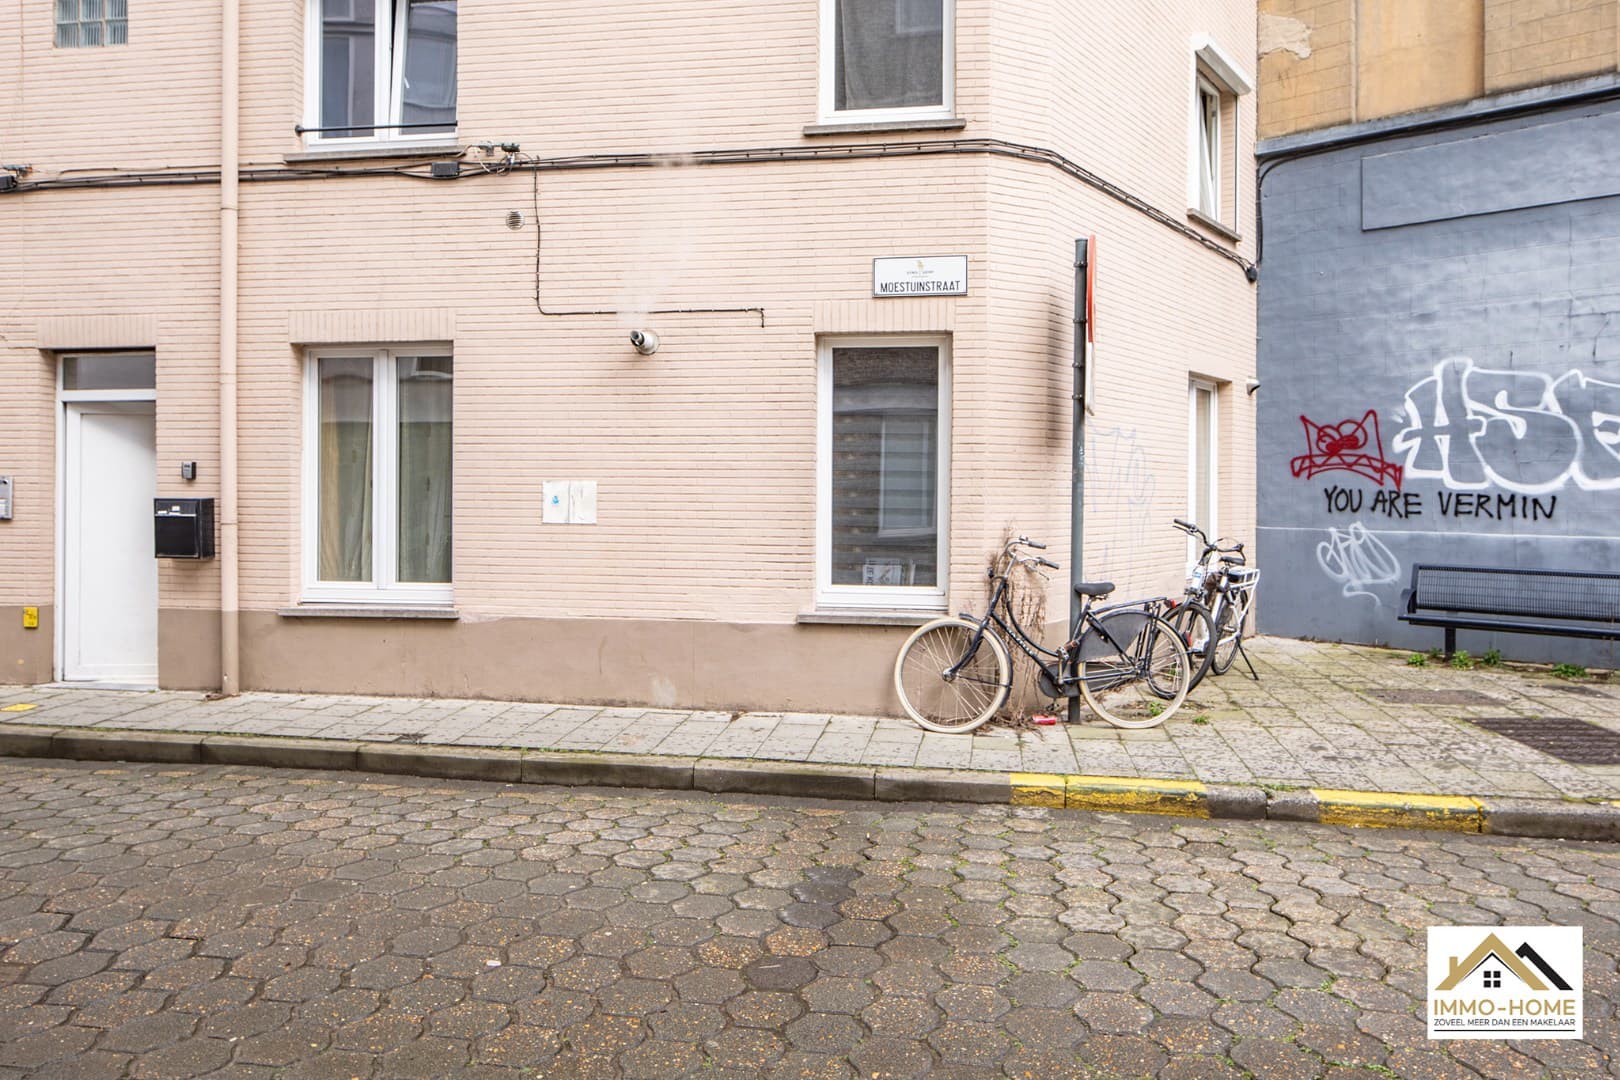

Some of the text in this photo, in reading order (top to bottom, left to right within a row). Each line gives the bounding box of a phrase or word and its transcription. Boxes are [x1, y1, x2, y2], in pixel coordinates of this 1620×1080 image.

[880, 280, 960, 293] MOESTUINSTRAAT
[1323, 485, 1557, 521] YOU ARE VERMIN
